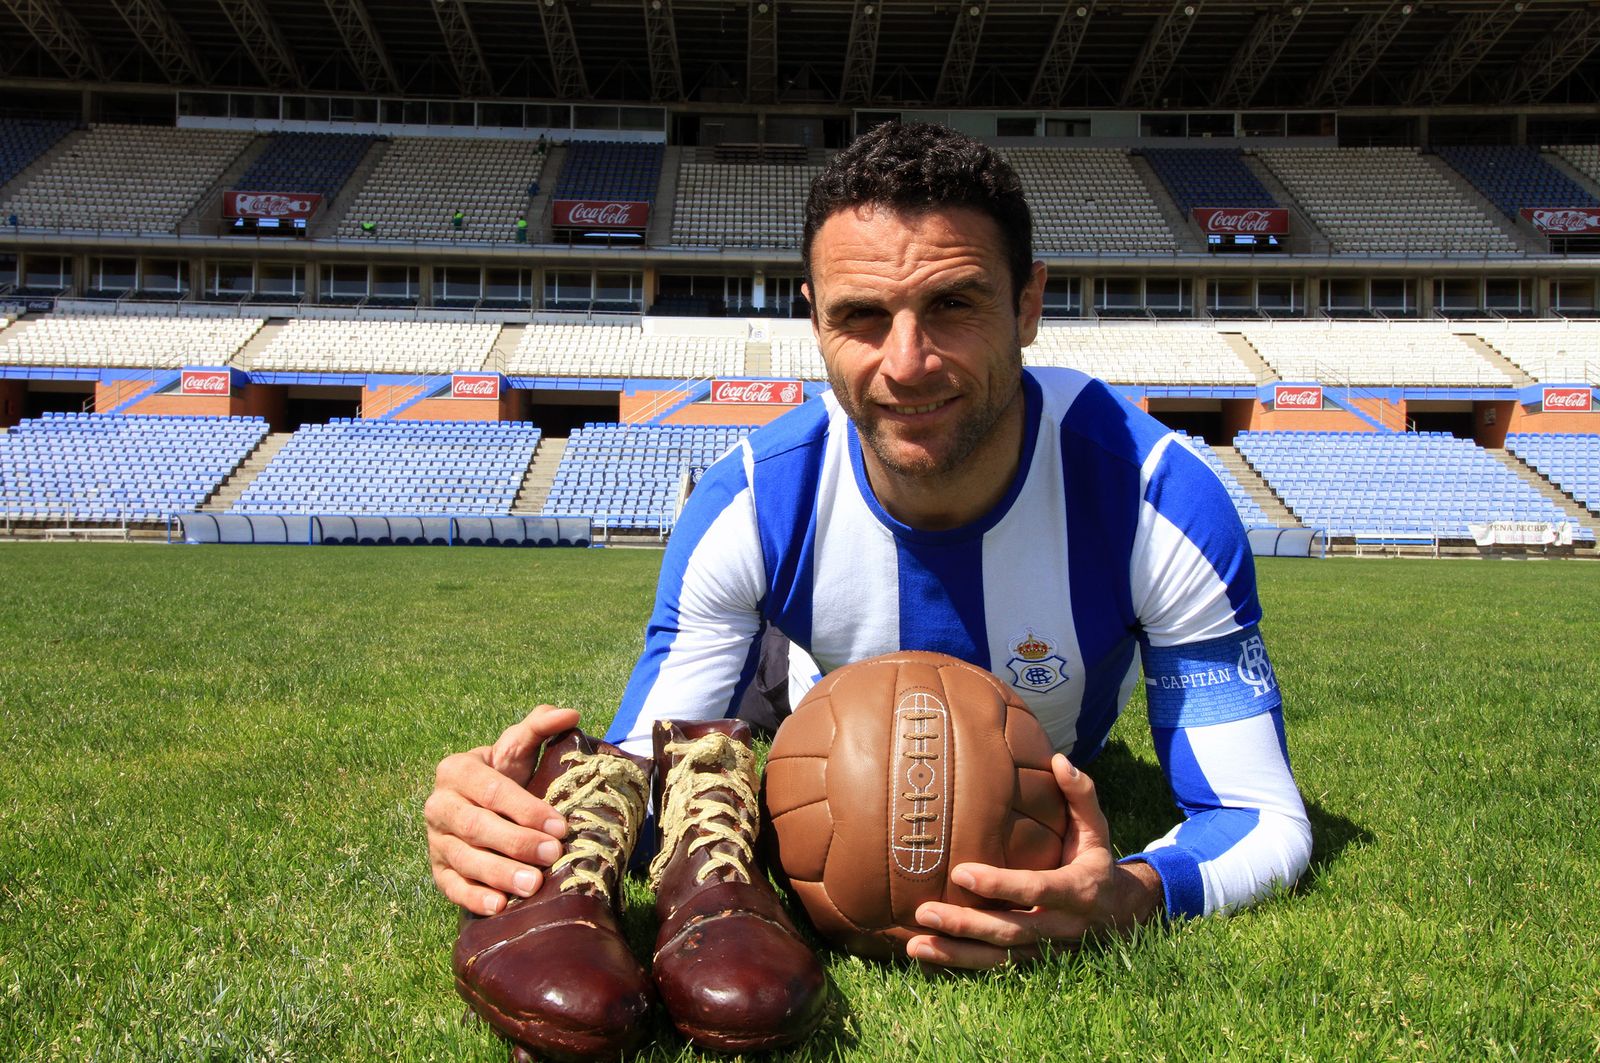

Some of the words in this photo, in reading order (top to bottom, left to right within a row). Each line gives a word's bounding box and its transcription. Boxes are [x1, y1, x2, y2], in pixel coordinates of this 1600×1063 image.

[568, 202, 632, 224] Coca-Cola
[1207, 210, 1273, 231] Coca-Cola
[183, 375, 227, 390] Coca-Cola
[454, 379, 496, 395] Coca-Cola
[716, 382, 774, 402] Coca-Cola
[1277, 390, 1319, 405] Coca-Cola
[1545, 392, 1589, 407] Coca-Cola
[1161, 668, 1231, 690] CAPITÁN
